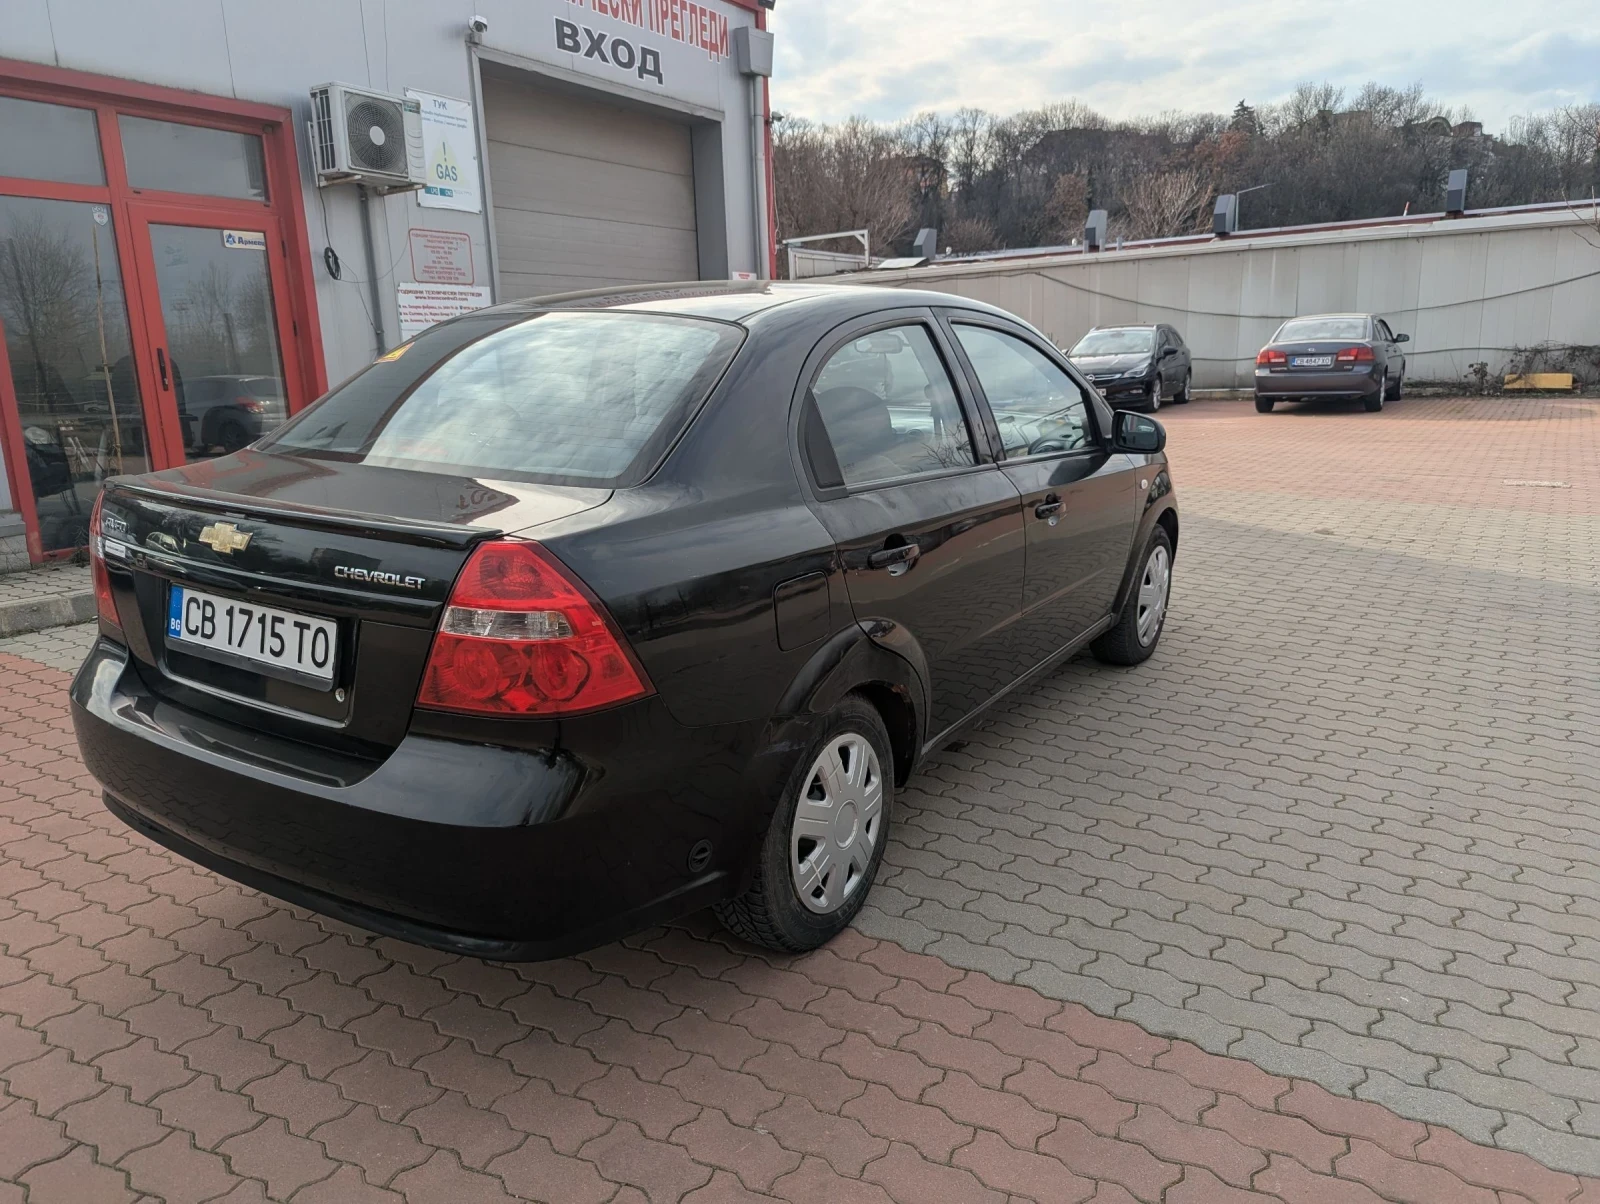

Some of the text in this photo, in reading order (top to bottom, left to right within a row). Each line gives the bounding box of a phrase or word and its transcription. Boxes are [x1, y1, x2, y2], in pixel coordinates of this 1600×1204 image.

[564, 0, 729, 63] ЕСКИ ПРЕГЛЕДИ
[554, 17, 664, 85] ВХОД
[432, 99, 448, 111] ТУК
[436, 163, 458, 182] GAS
[334, 565, 426, 590] CHEVROLET
[170, 617, 181, 631] BG
[185, 596, 330, 669] CB 1715 TO
